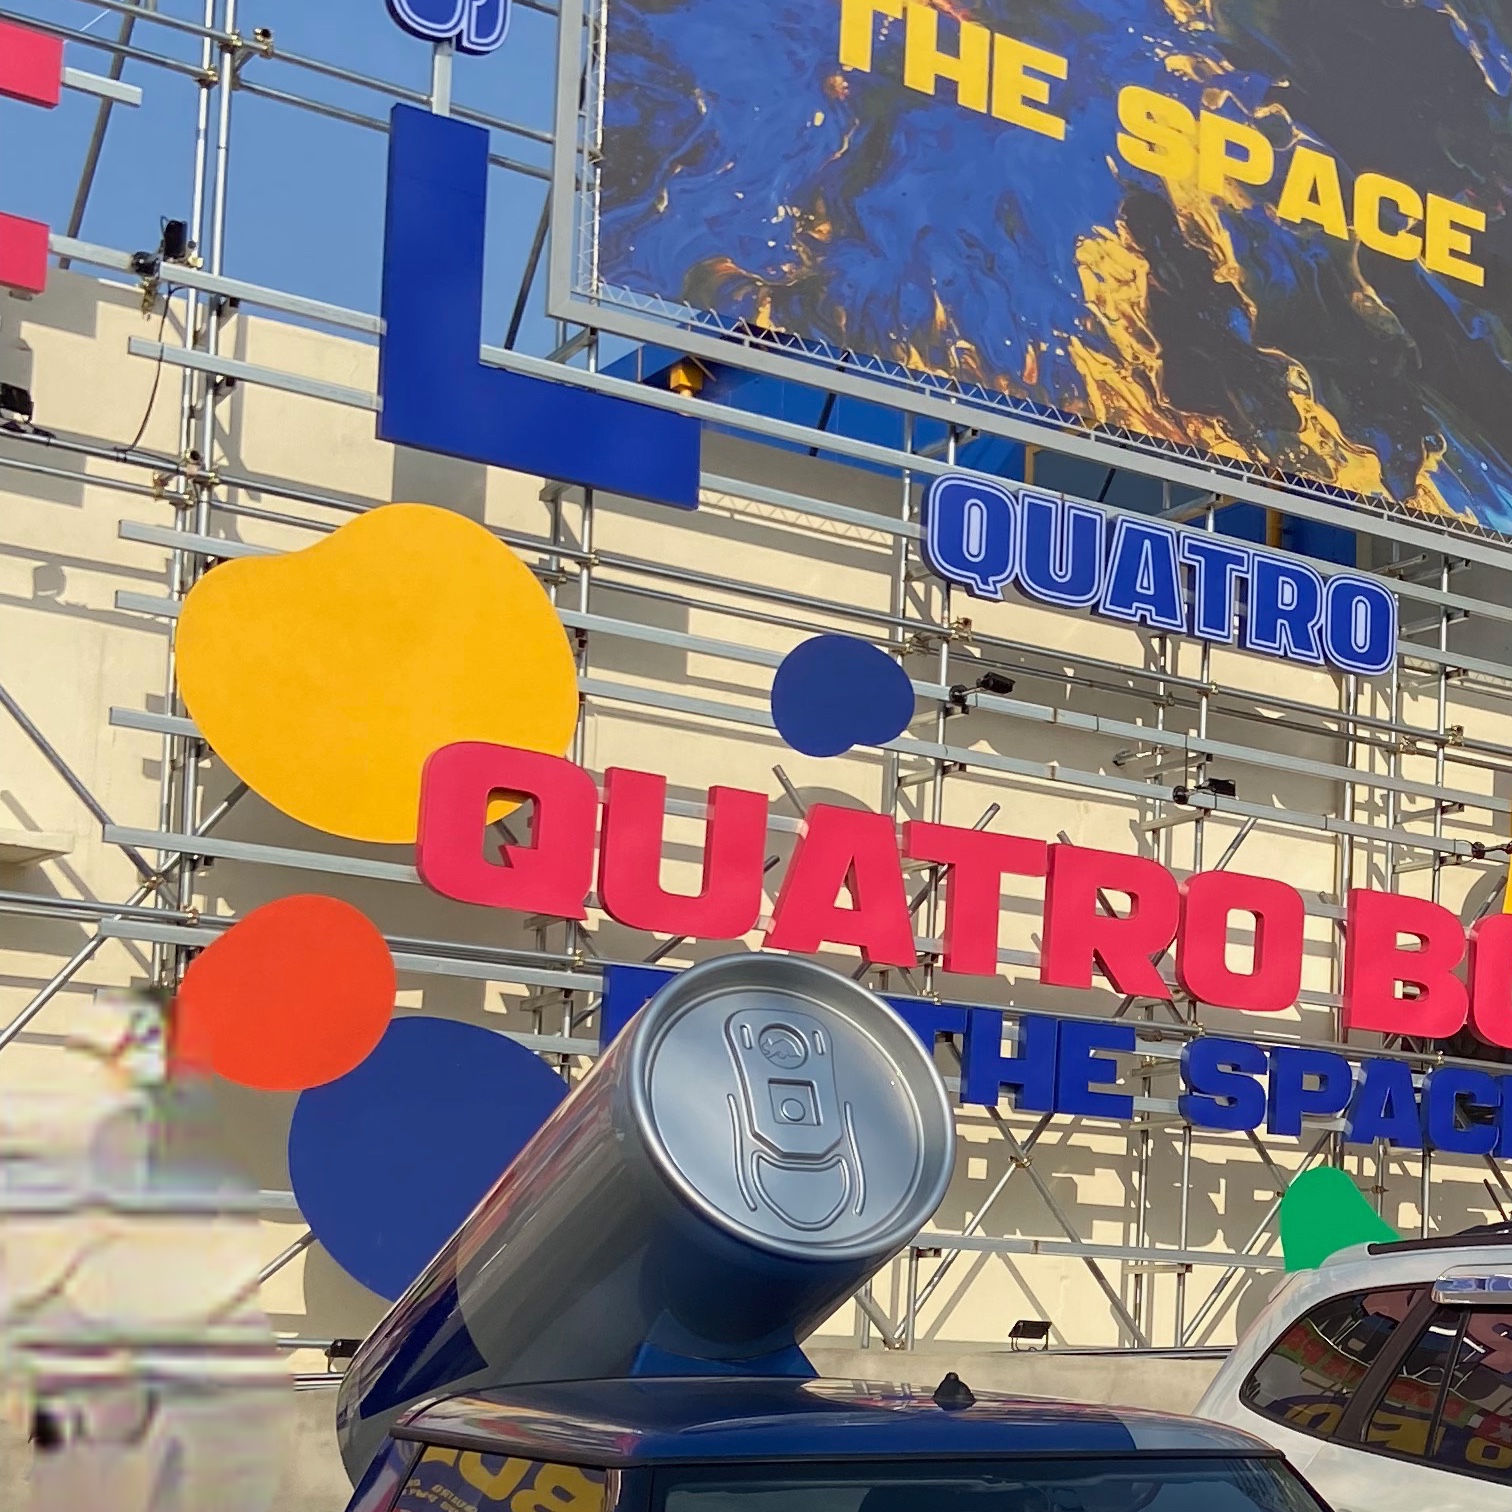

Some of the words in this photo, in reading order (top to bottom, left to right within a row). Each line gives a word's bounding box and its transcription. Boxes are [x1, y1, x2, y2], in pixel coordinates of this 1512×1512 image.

[837, 0, 1069, 141] THE
[1116, 85, 1486, 287] SPACE
[922, 472, 1399, 677] QUATRO
[416, 741, 1305, 1012] QUATRO
